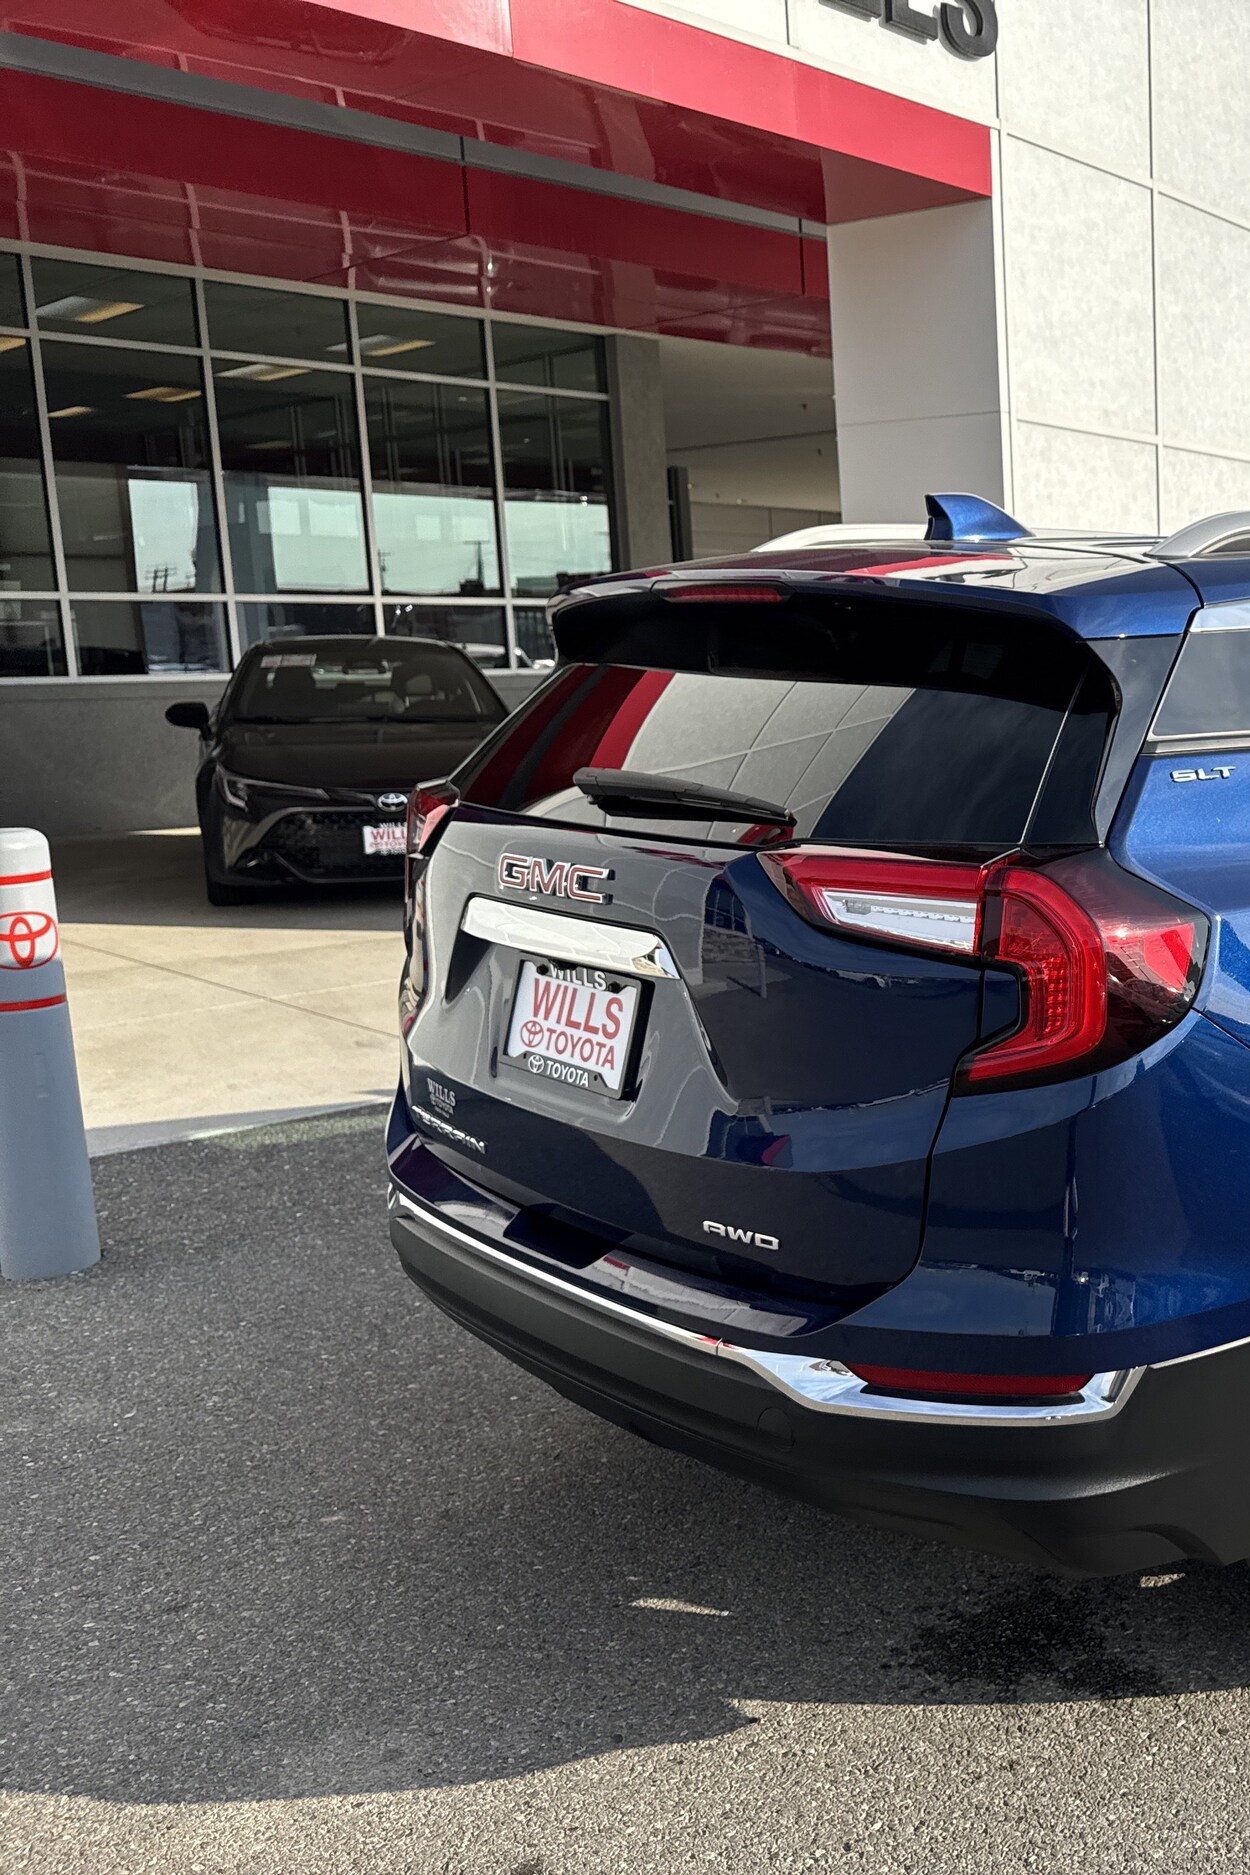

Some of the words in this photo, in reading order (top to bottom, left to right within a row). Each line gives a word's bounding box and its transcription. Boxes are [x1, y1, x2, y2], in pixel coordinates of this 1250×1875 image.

[1170, 765, 1236, 783] SLT
[498, 852, 612, 905] GMC
[550, 962, 607, 991] WILLS
[532, 977, 624, 1040] WILLS
[545, 1027, 616, 1071] TOYOTA
[545, 1060, 590, 1088] TOYOTA
[426, 1077, 456, 1107] WILLS
[702, 1220, 780, 1251] AWD
